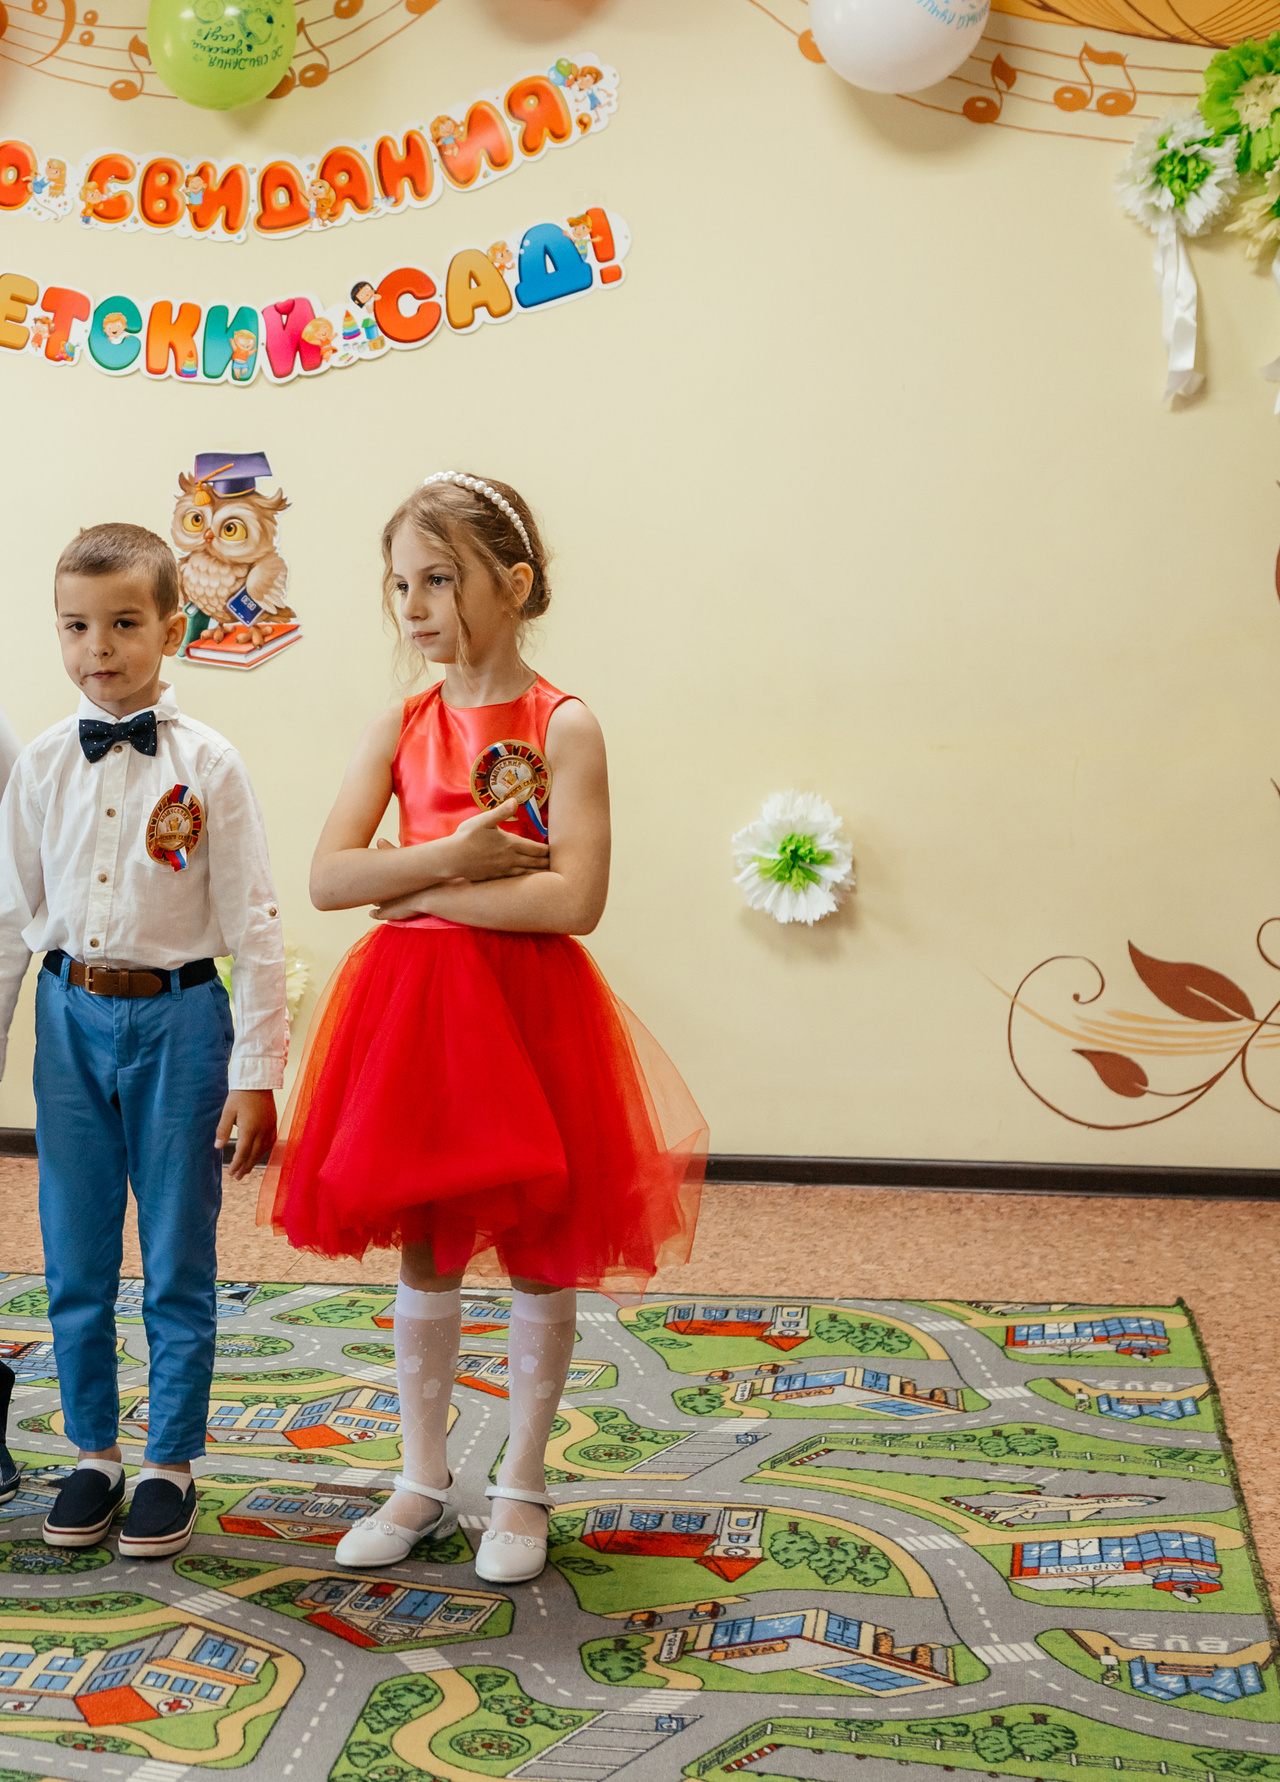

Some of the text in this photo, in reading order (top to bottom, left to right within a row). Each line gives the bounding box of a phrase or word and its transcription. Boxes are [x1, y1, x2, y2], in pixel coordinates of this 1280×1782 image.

[203, 25, 235, 40] сад!
[84, 74, 593, 236] СВИДАНИЯ,
[372, 207, 621, 343] САД!
[1028, 1336, 1094, 1346] AIRPORT
[1097, 1382, 1173, 1393] BUS
[784, 1390, 824, 1400] WASH
[1041, 1562, 1121, 1575] AIRPORT
[1128, 1637, 1228, 1654] BUS
[724, 1646, 775, 1660] WASH
